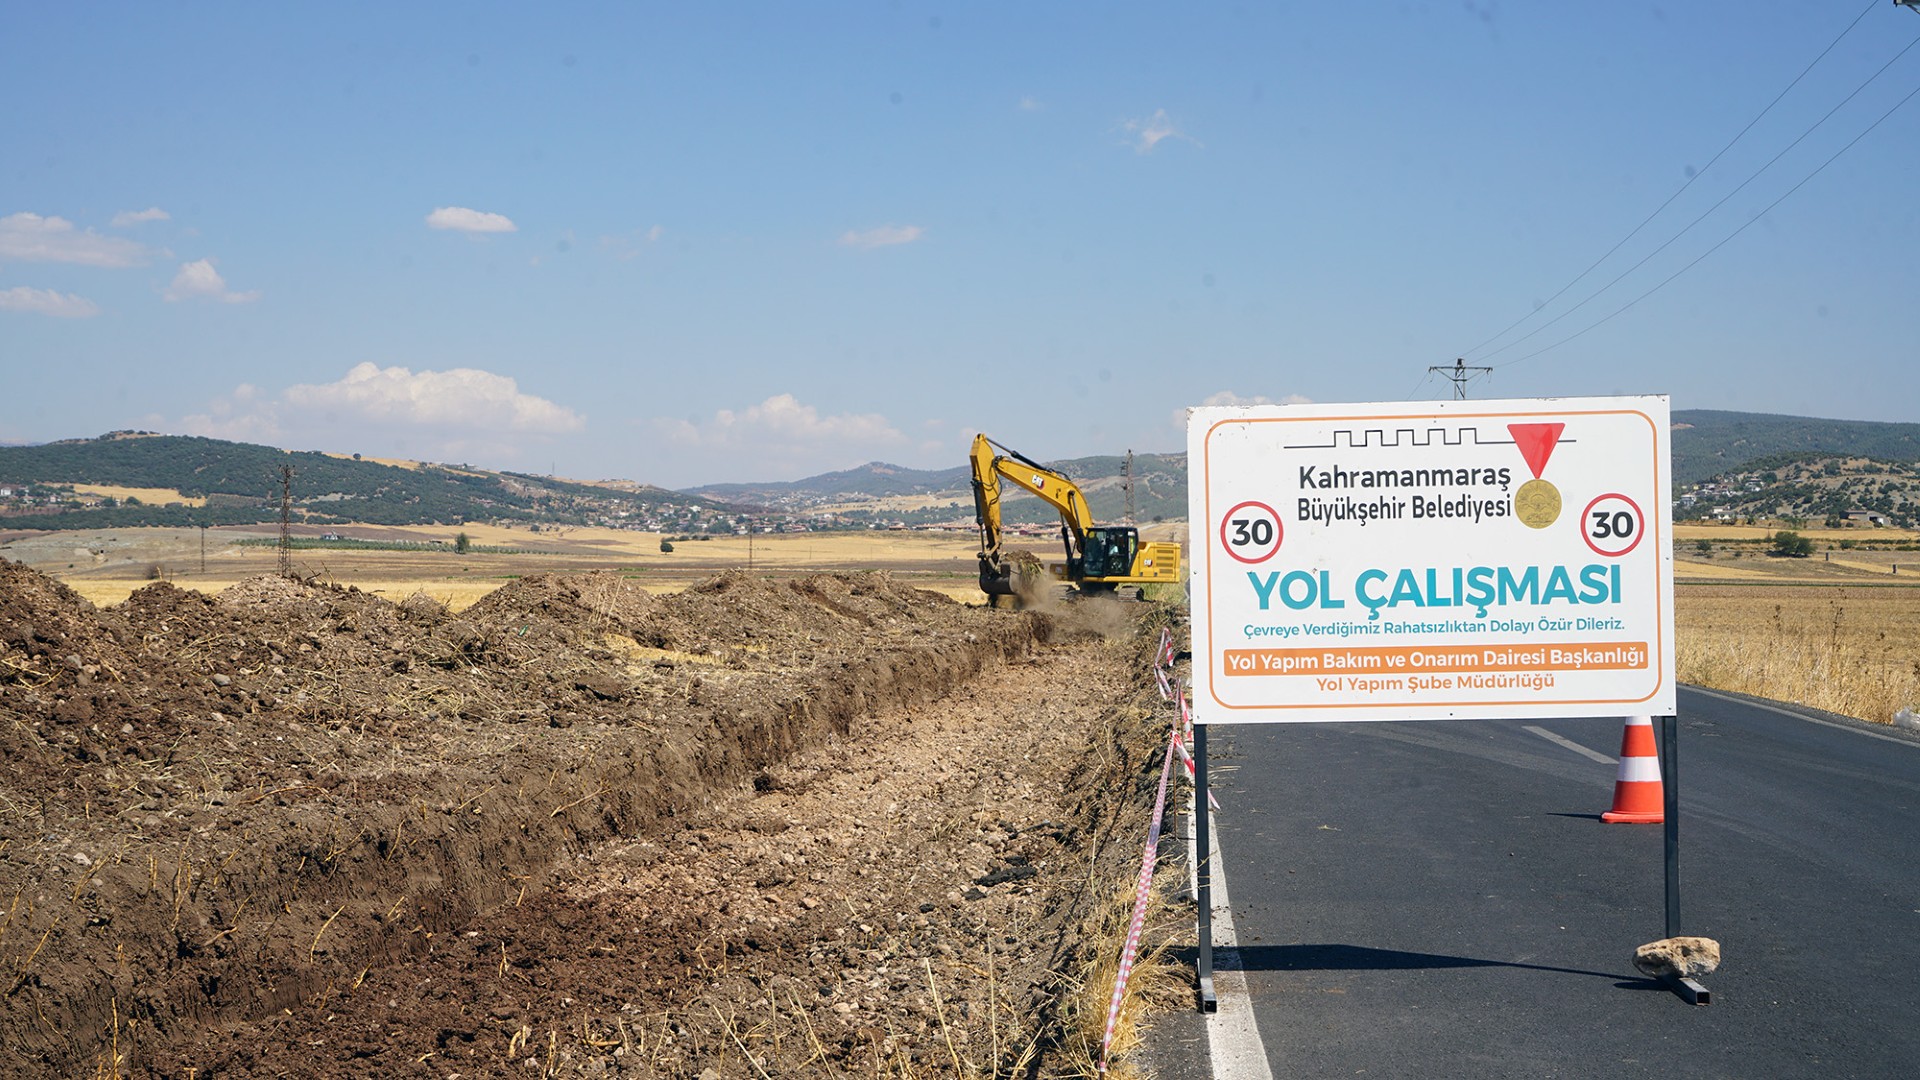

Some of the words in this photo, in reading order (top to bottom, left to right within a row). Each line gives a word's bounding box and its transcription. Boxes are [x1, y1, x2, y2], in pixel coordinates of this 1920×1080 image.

[1299, 464, 1511, 491] Kahramanmaraş
[1297, 495, 1405, 527] Büyükşehir
[1412, 492, 1511, 523] Belediyesi
[1231, 518, 1273, 546] 30
[1591, 511, 1634, 539] 30
[1246, 570, 1345, 611] YOL
[1354, 563, 1622, 620] ÇALIŞMASI
[1243, 624, 1300, 640] Çevreye
[1302, 621, 1380, 637] Verdiğimiz
[1383, 618, 1487, 635] Rahatsızlıktan
[1489, 617, 1535, 634] Dolayı
[1537, 615, 1573, 632] Özür
[1576, 616, 1625, 631] Dileriz.
[1228, 654, 1257, 671] Yol
[1260, 655, 1319, 673] Yapım
[1323, 652, 1380, 669] Bakım
[1385, 655, 1406, 668] ve
[1409, 651, 1479, 667] Onarım
[1483, 649, 1546, 666] Dairesi
[1550, 647, 1645, 668] Başkanlığı
[1316, 677, 1343, 692] Yol
[1347, 677, 1403, 695] Yapım
[1407, 675, 1453, 693] Şube
[1457, 672, 1555, 691] Müdürlüğü
